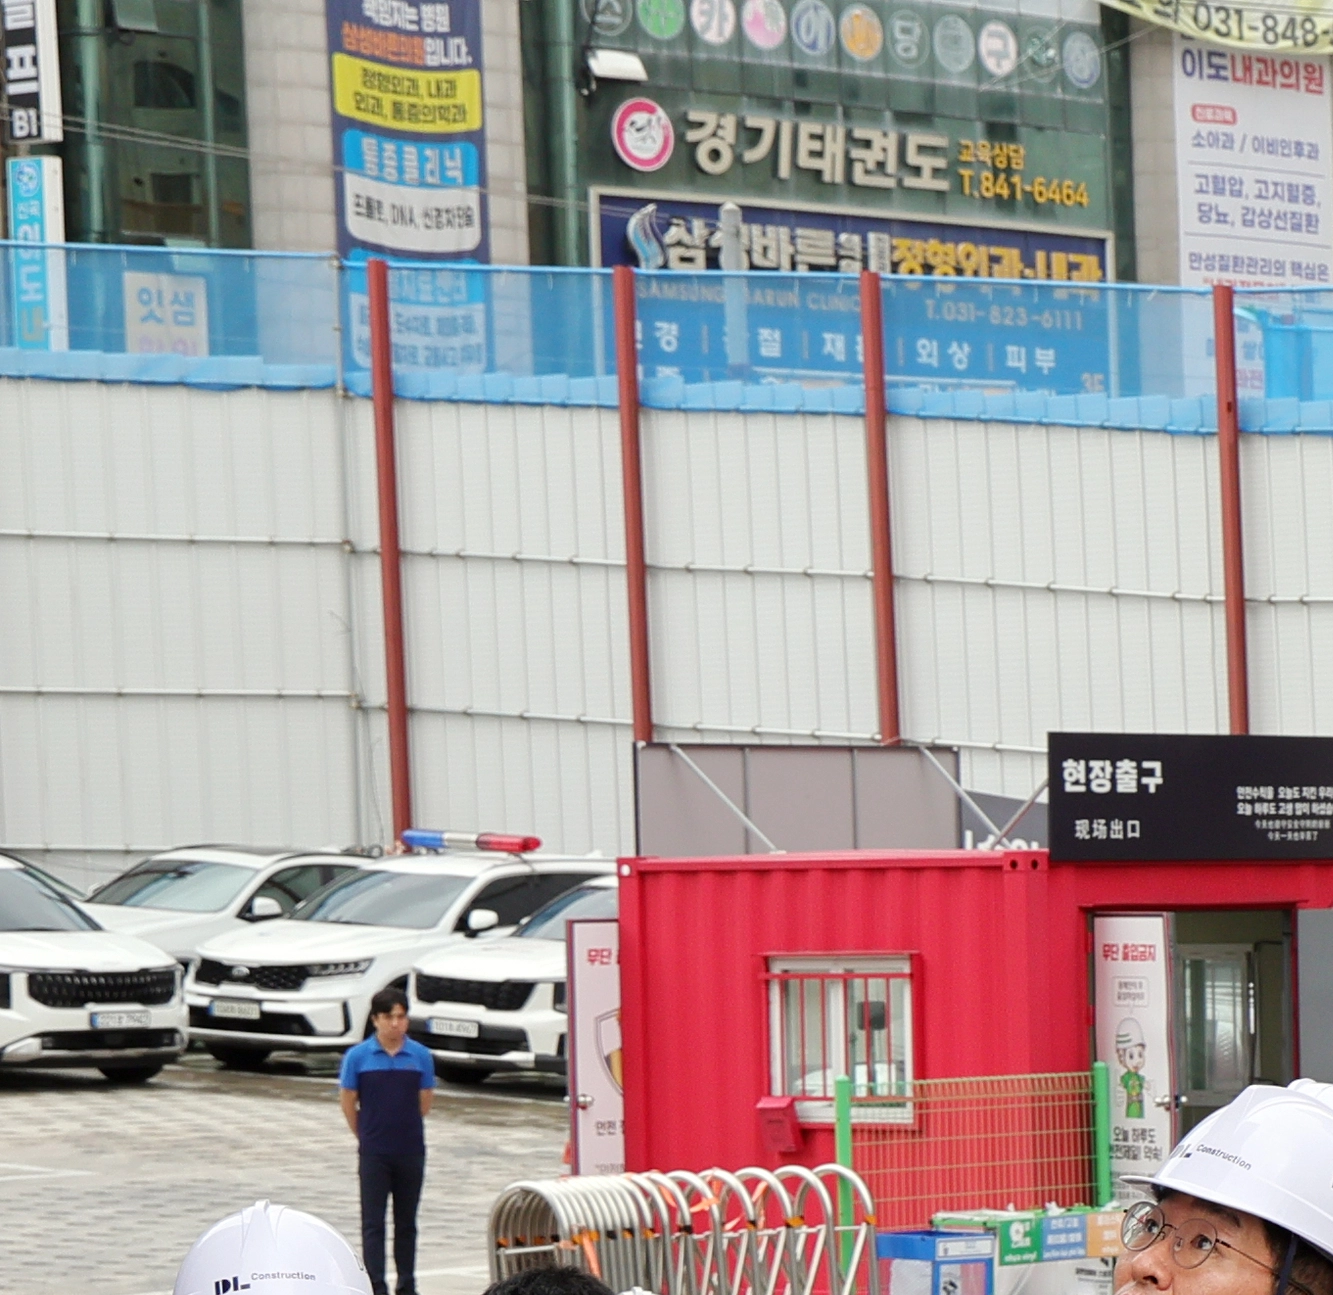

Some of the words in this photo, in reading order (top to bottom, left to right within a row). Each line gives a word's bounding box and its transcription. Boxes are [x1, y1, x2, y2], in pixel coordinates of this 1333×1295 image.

[420, 3, 451, 33] 병원
[428, 74, 457, 99] 내과
[1181, 48, 1325, 95] 이도내과의원
[12, 108, 39, 138] B1
[685, 108, 950, 192] 경기태권도
[958, 140, 1025, 170] 교육상담
[1191, 130, 1235, 151] 소아과
[361, 136, 465, 186] 통증클리닉
[959, 170, 1090, 207] T.841-6464
[1241, 207, 1320, 235] 갑상선질환
[740, 290, 800, 308] ARUN
[916, 338, 973, 370] 외상
[1005, 345, 1056, 374] 피부
[1062, 758, 1164, 794] 현장출구
[1074, 819, 1141, 840] 现场出口
[1195, 1143, 1252, 1171] Construction
[250, 1271, 316, 1281] Construction
